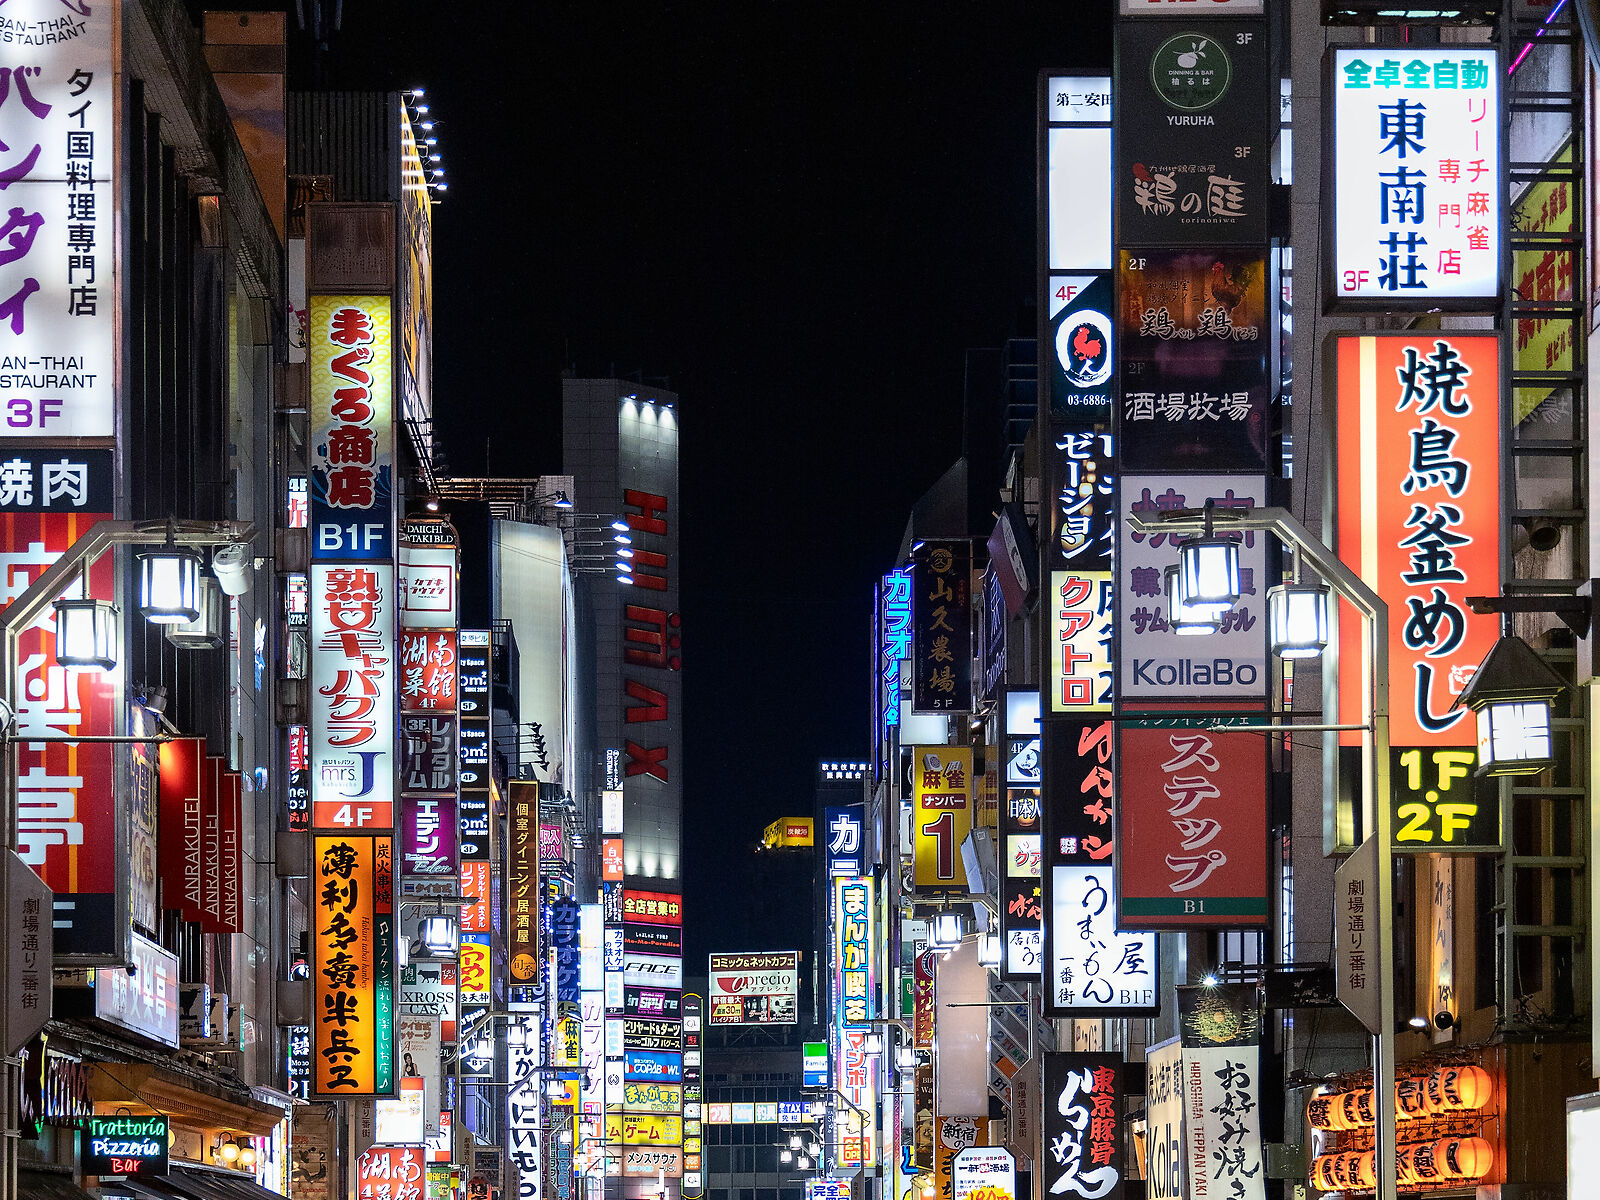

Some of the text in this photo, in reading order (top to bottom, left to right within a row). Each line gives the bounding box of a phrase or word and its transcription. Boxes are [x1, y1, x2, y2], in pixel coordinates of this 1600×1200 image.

[1236, 33, 1253, 45] 3F
[1343, 59, 1490, 90] 全卓全自動
[1166, 115, 1215, 126] YURUHA
[1234, 147, 1251, 158] 3F
[1466, 98, 1490, 251] リーチ麻雀
[66, 68, 97, 317] タイ国料理専門店
[1378, 98, 1428, 291] 東南荘
[1437, 158, 1461, 275] 専門店
[1129, 259, 1147, 270] 2F
[1055, 285, 1077, 301] 4F
[1343, 270, 1370, 292] 3F
[7, 399, 63, 428] 3F
[329, 307, 376, 508] まぐろ商店
[1124, 391, 1253, 422] 酒場牧場
[0, 459, 88, 507] 焼肉
[319, 524, 384, 551] B1F
[1394, 339, 1474, 735] 焼鳥釜めし
[1058, 574, 1093, 707] クアトロ
[319, 567, 390, 750] 熟女キャバクラ
[1131, 658, 1257, 686] KollaBo
[418, 698, 439, 709] 4F
[462, 702, 474, 711] 5F
[933, 699, 953, 708] 5F
[407, 719, 428, 731] 3F
[431, 718, 450, 790] レンタル
[922, 769, 966, 790] 麻雀
[1399, 749, 1477, 791] 1F
[923, 796, 966, 807] ナンバー
[1160, 734, 1228, 893] ステップ
[332, 804, 373, 827] 4F
[415, 800, 441, 855] エデン
[1396, 803, 1478, 842] 2F
[184, 797, 199, 904] ANRAKUTEI
[463, 845, 474, 853] 3F
[205, 813, 217, 916] ANRAKUTEI
[376, 844, 392, 905] 炭火串焼
[515, 803, 530, 943] 個室ダイニング居酒屋
[224, 829, 236, 927] ANRAKUTEI
[624, 897, 679, 918] 全店営業中
[1183, 899, 1207, 915] B1
[555, 903, 577, 987] カラオケ
[1347, 878, 1366, 989] 劇場通り一番街
[21, 897, 40, 1010] 劇場通り一番街
[614, 930, 623, 966] カラオケ
[624, 962, 680, 975] FACE
[713, 956, 795, 968] コミック&ネットカフェ
[1057, 956, 1077, 1005] 一番街
[403, 991, 454, 1004] XROSS
[409, 1003, 449, 1015] CASA
[1118, 988, 1153, 1005] B1F
[565, 1020, 578, 1059] 麻雀
[624, 1021, 681, 1036] ビリヤード&ダーツ
[640, 1037, 660, 1048] ゴルフ
[846, 1031, 867, 1106] マンボー
[624, 1084, 680, 1104] まんが喫茶
[785, 1103, 802, 1113] TAX
[1089, 1065, 1116, 1167] 東京豚骨
[90, 1118, 165, 1137] Trattoria
[625, 1124, 660, 1140] ゲーム
[92, 1139, 160, 1158] Pizzeria
[627, 1152, 678, 1164] メンズサウナ
[844, 1149, 871, 1161] OPEN
[111, 1157, 142, 1174] Bar
[813, 1185, 839, 1197] 完全
